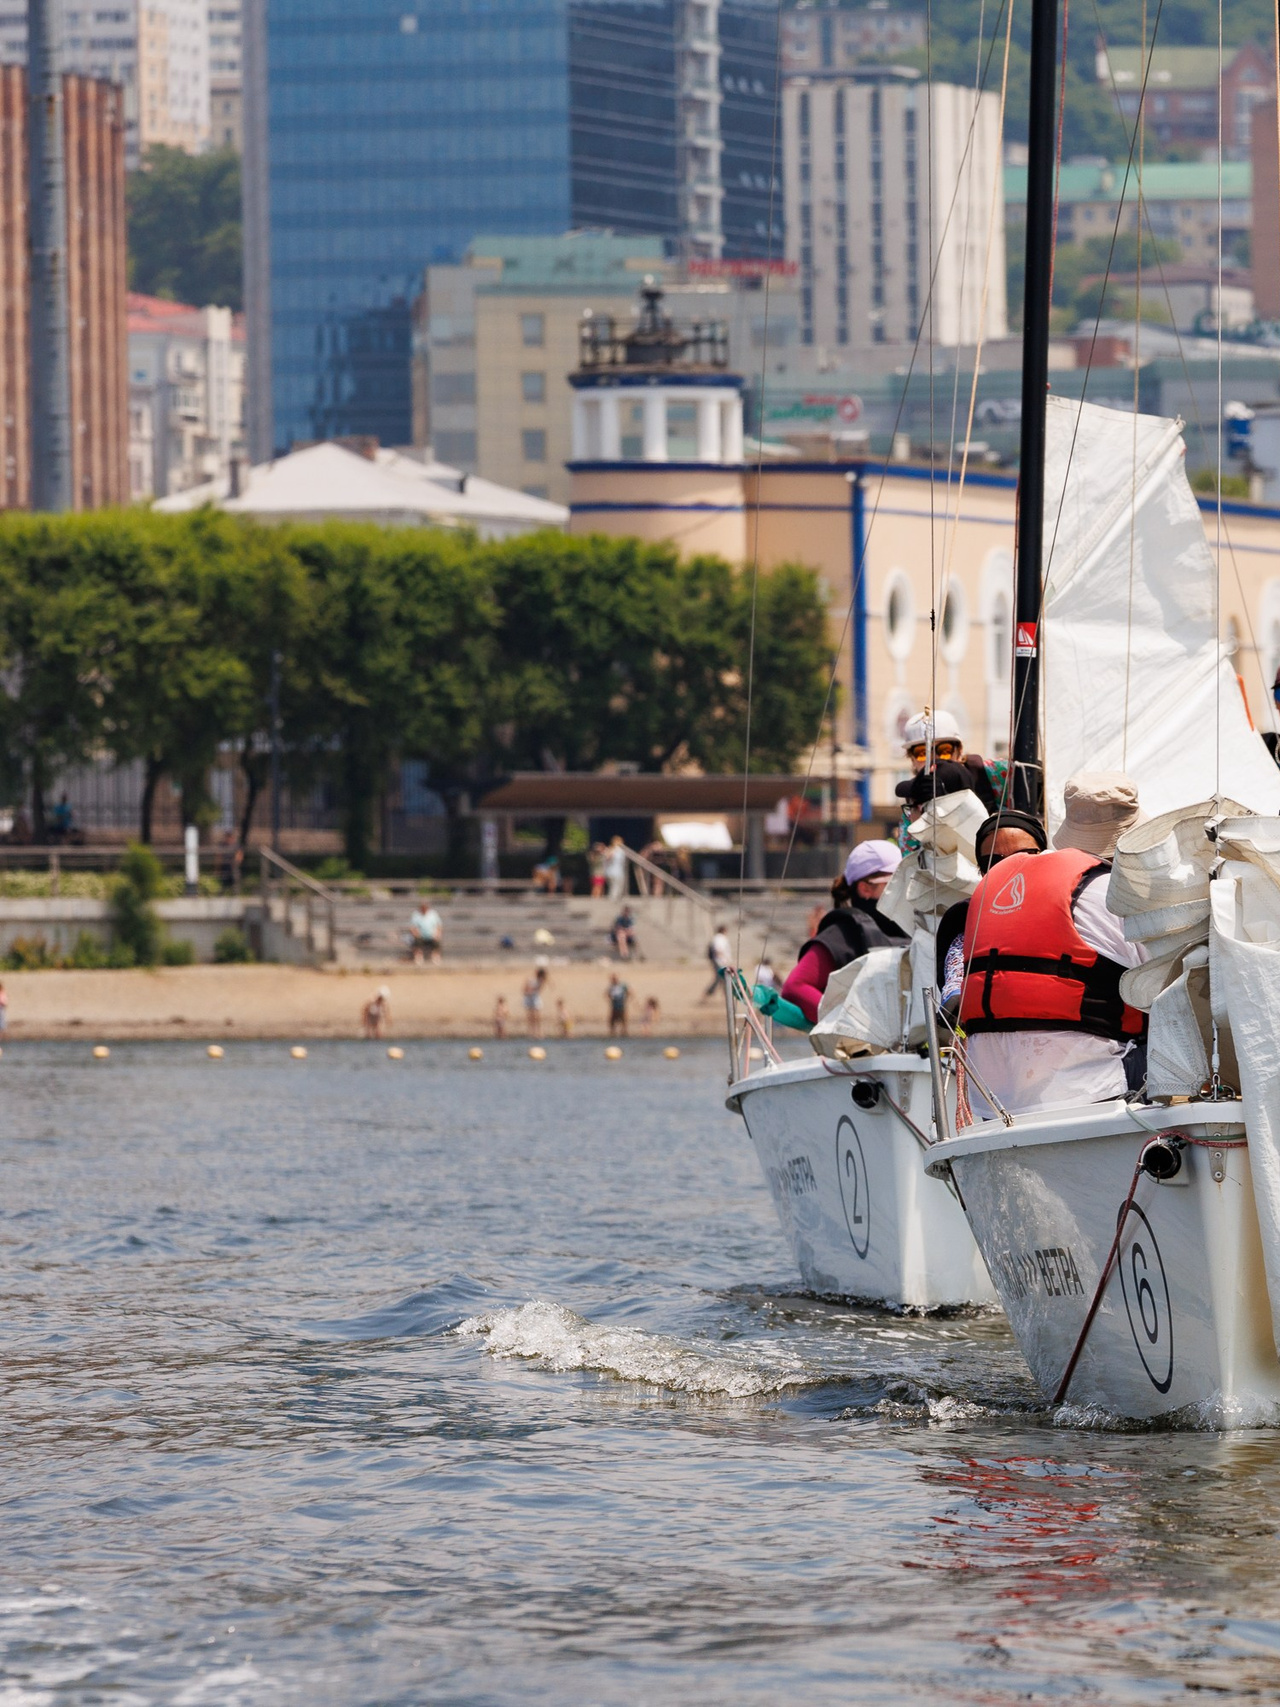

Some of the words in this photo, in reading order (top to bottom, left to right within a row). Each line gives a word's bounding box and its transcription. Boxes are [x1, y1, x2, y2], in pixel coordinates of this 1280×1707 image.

[845, 1149, 863, 1224] 2
[1035, 1247, 1085, 1297] ВЕТРА
[1132, 1242, 1158, 1344] 6
